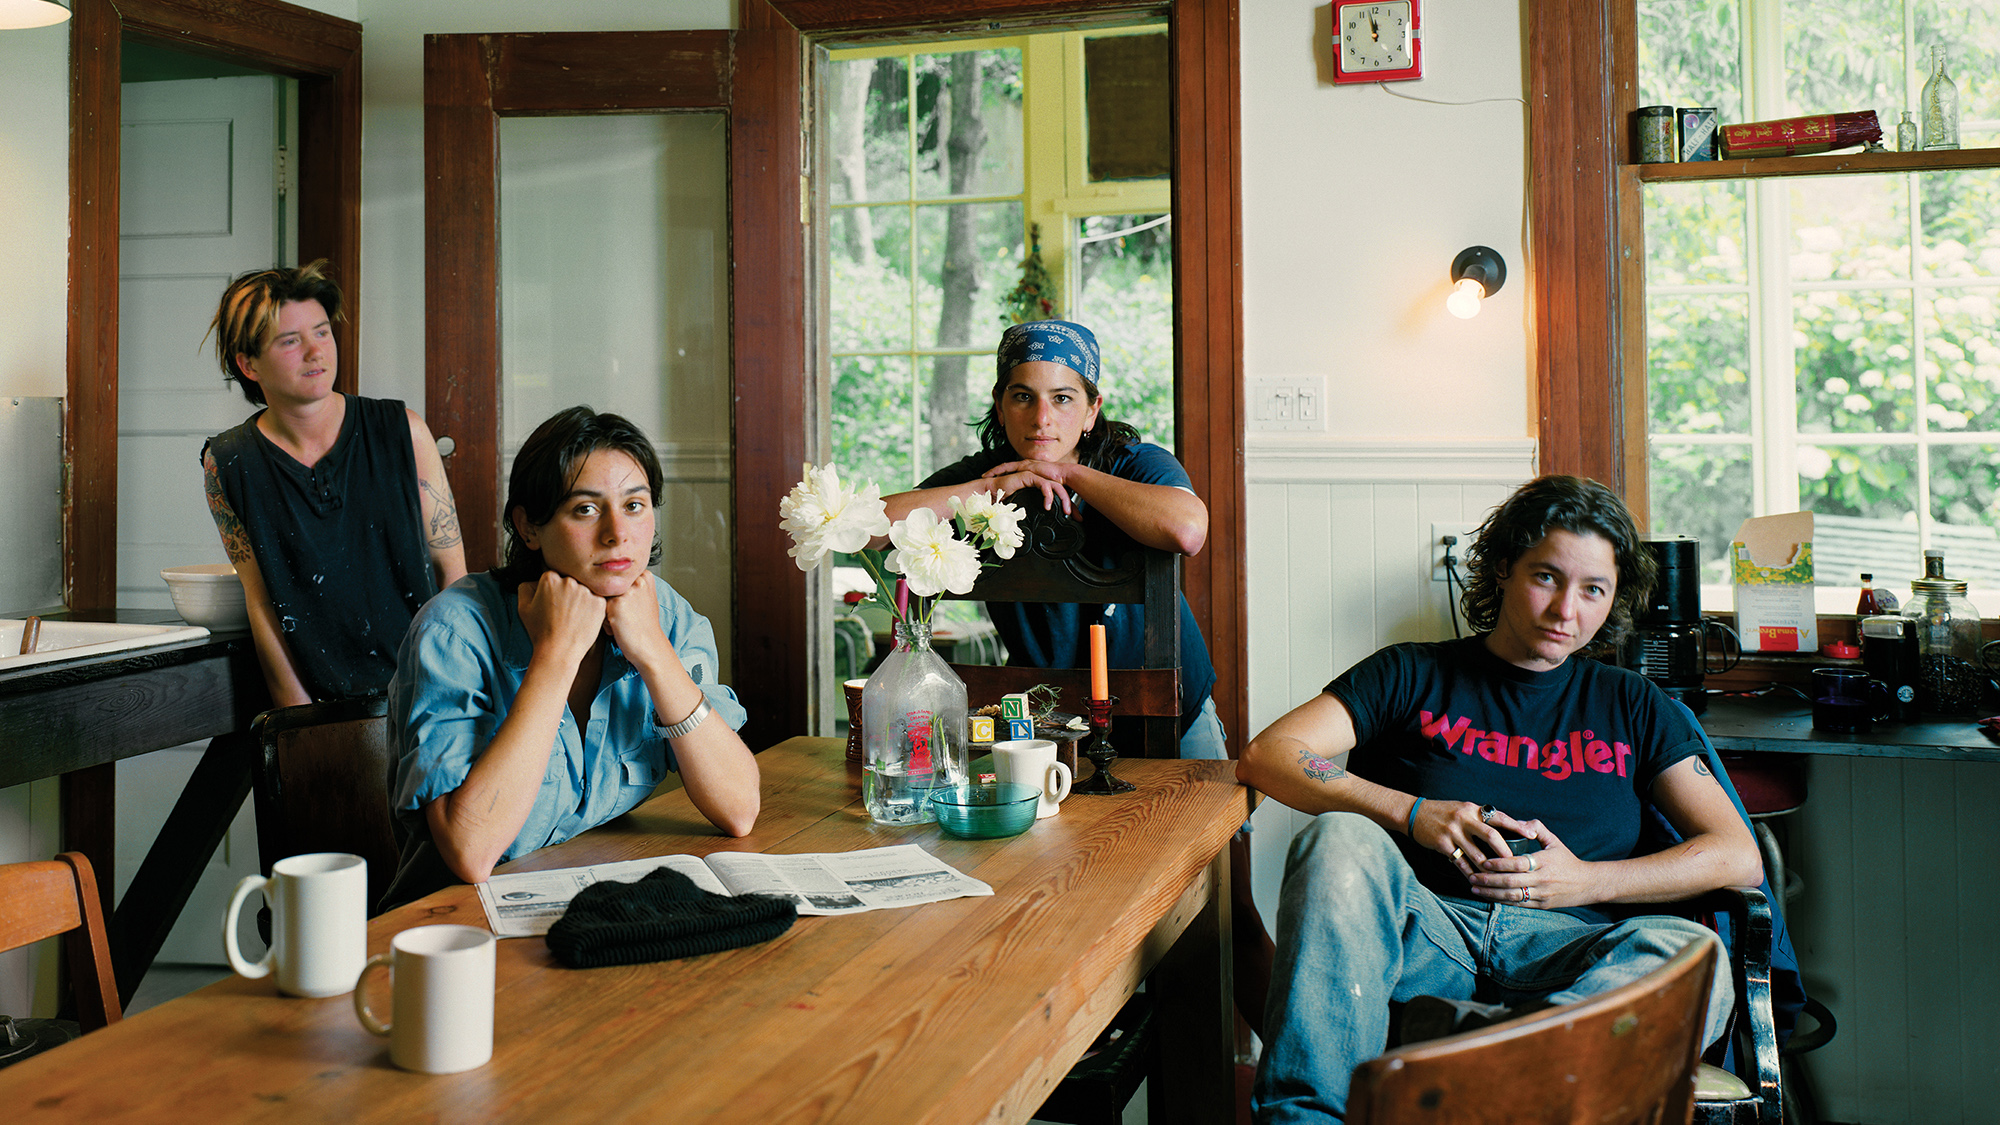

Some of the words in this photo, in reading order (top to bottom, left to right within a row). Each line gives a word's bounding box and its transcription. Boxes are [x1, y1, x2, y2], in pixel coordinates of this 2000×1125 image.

[1359, 11, 1365, 19] 11
[1372, 7, 1379, 15] 12
[1348, 21, 1357, 29] 10
[1397, 18, 1403, 26] 2
[1396, 44, 1402, 52] 4
[1360, 57, 1366, 65] 7
[1374, 59, 1380, 67] 6
[1387, 55, 1393, 63] 5
[1004, 701, 1020, 717] N
[976, 722, 991, 738] C
[1420, 710, 1632, 781] Wrangler
